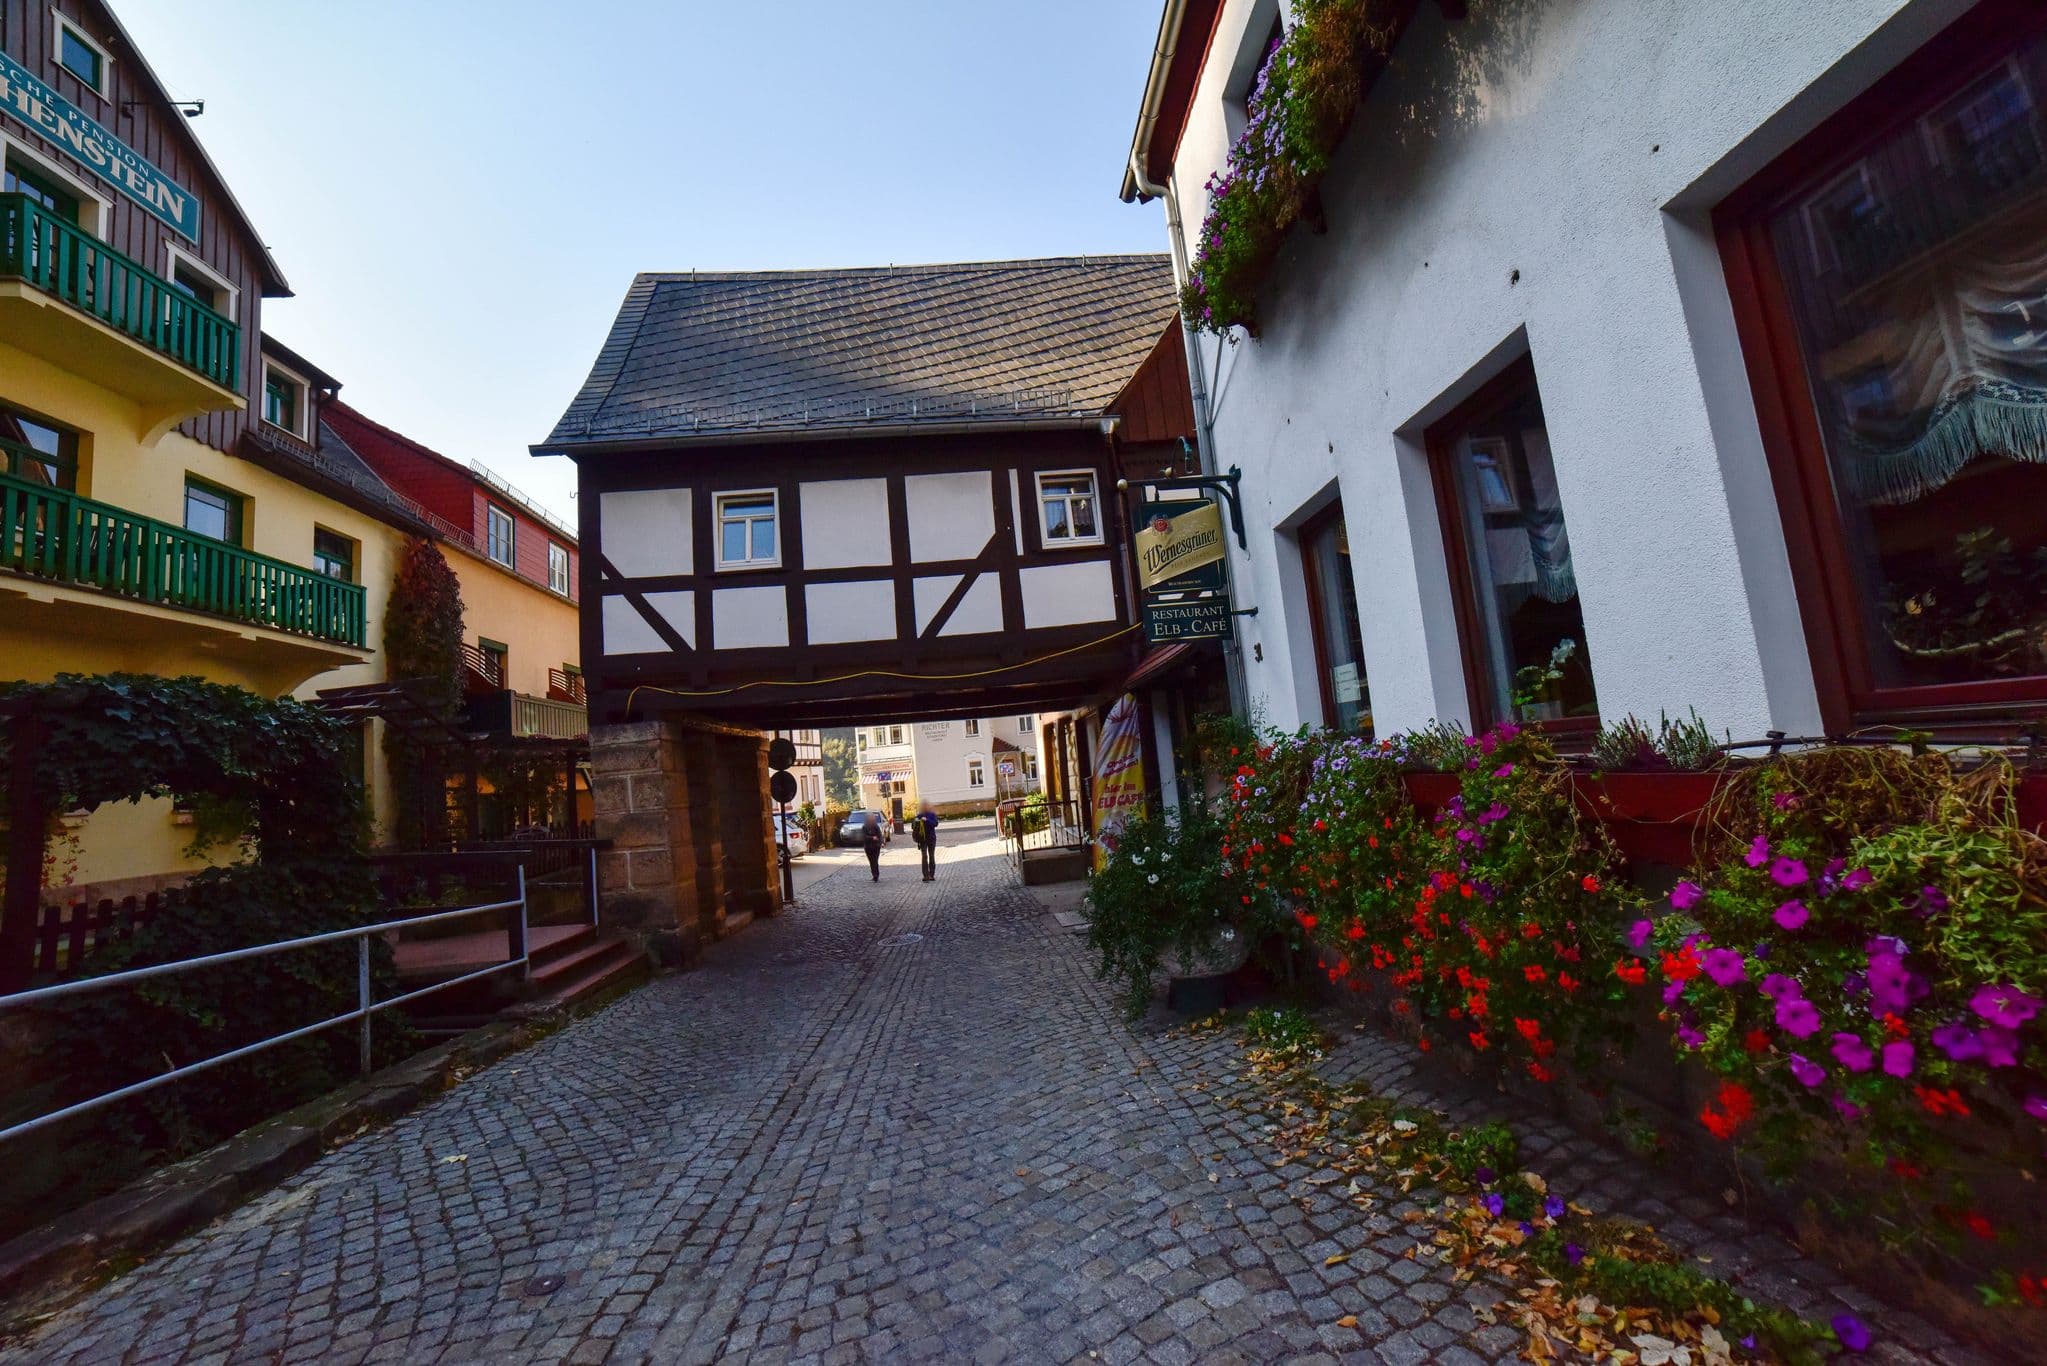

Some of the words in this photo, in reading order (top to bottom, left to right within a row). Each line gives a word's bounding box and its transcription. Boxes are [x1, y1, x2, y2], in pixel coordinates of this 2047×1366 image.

[69, 111, 149, 176] PENSION
[1143, 529, 1217, 573] Wernesgrüner
[1152, 605, 1225, 620] RESTAURANT
